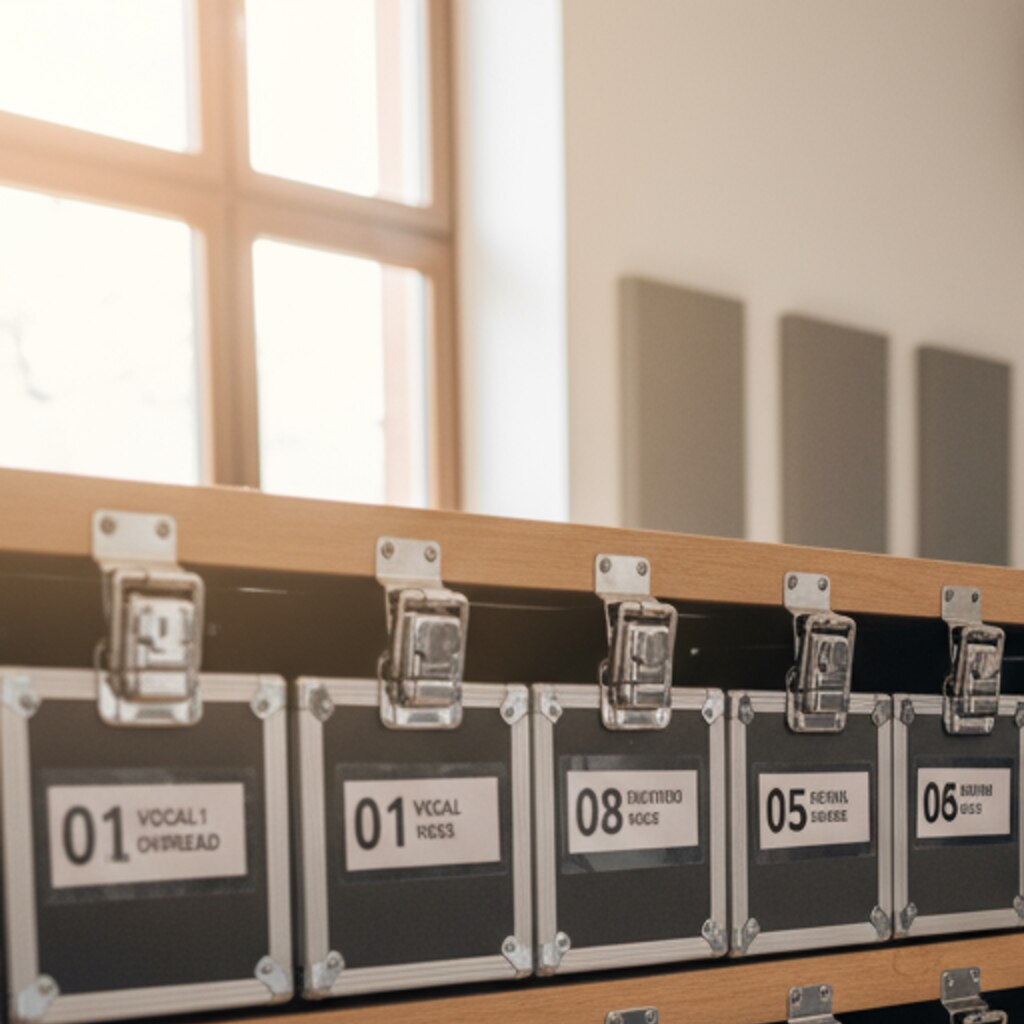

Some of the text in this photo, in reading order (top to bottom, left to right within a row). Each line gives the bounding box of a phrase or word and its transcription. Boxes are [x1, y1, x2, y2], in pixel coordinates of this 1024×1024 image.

[354, 796, 406, 850] 01
[575, 787, 624, 836] 08
[766, 787, 808, 834] 05
[923, 781, 959, 824] 06
[63, 805, 130, 866] 01
